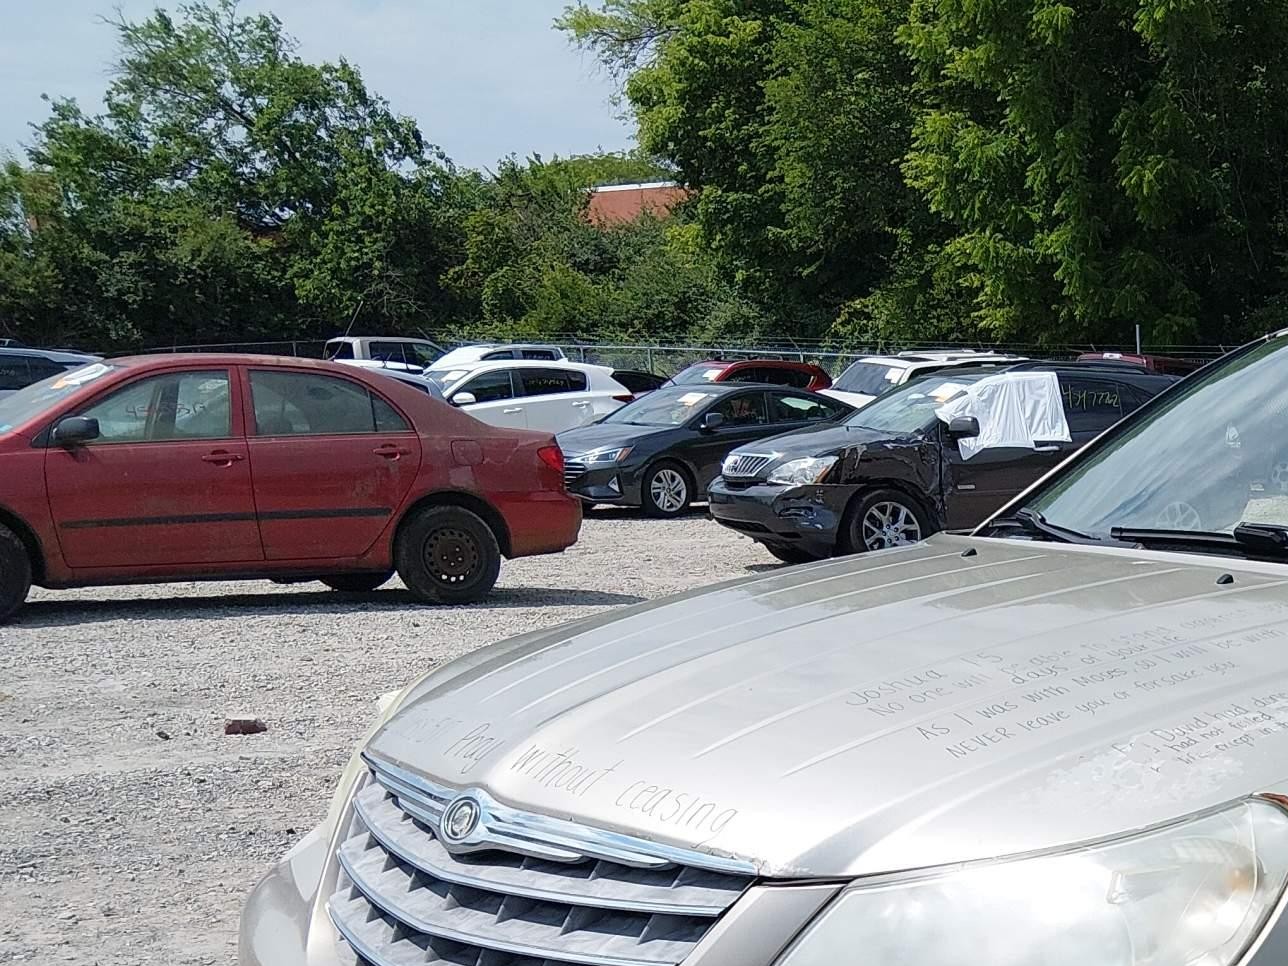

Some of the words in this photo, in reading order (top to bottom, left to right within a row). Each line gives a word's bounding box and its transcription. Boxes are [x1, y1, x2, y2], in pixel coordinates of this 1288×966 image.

[845, 669, 947, 706] Joshua
[867, 702, 905, 717] No
[908, 687, 953, 703] one
[951, 672, 993, 689] will
[975, 700, 1019, 719] was
[1021, 686, 1072, 703] with
[1169, 644, 1210, 659] will
[1001, 664, 1069, 685] days
[945, 725, 1016, 759] NEVER
[1017, 708, 1071, 732] leave
[1074, 699, 1109, 716] you
[1150, 716, 1209, 742] David
[1203, 703, 1250, 721] had
[1163, 736, 1200, 752] had
[1199, 726, 1225, 740] not
[443, 722, 504, 775] Pray
[509, 743, 625, 797] without
[615, 779, 739, 848] ceasing
